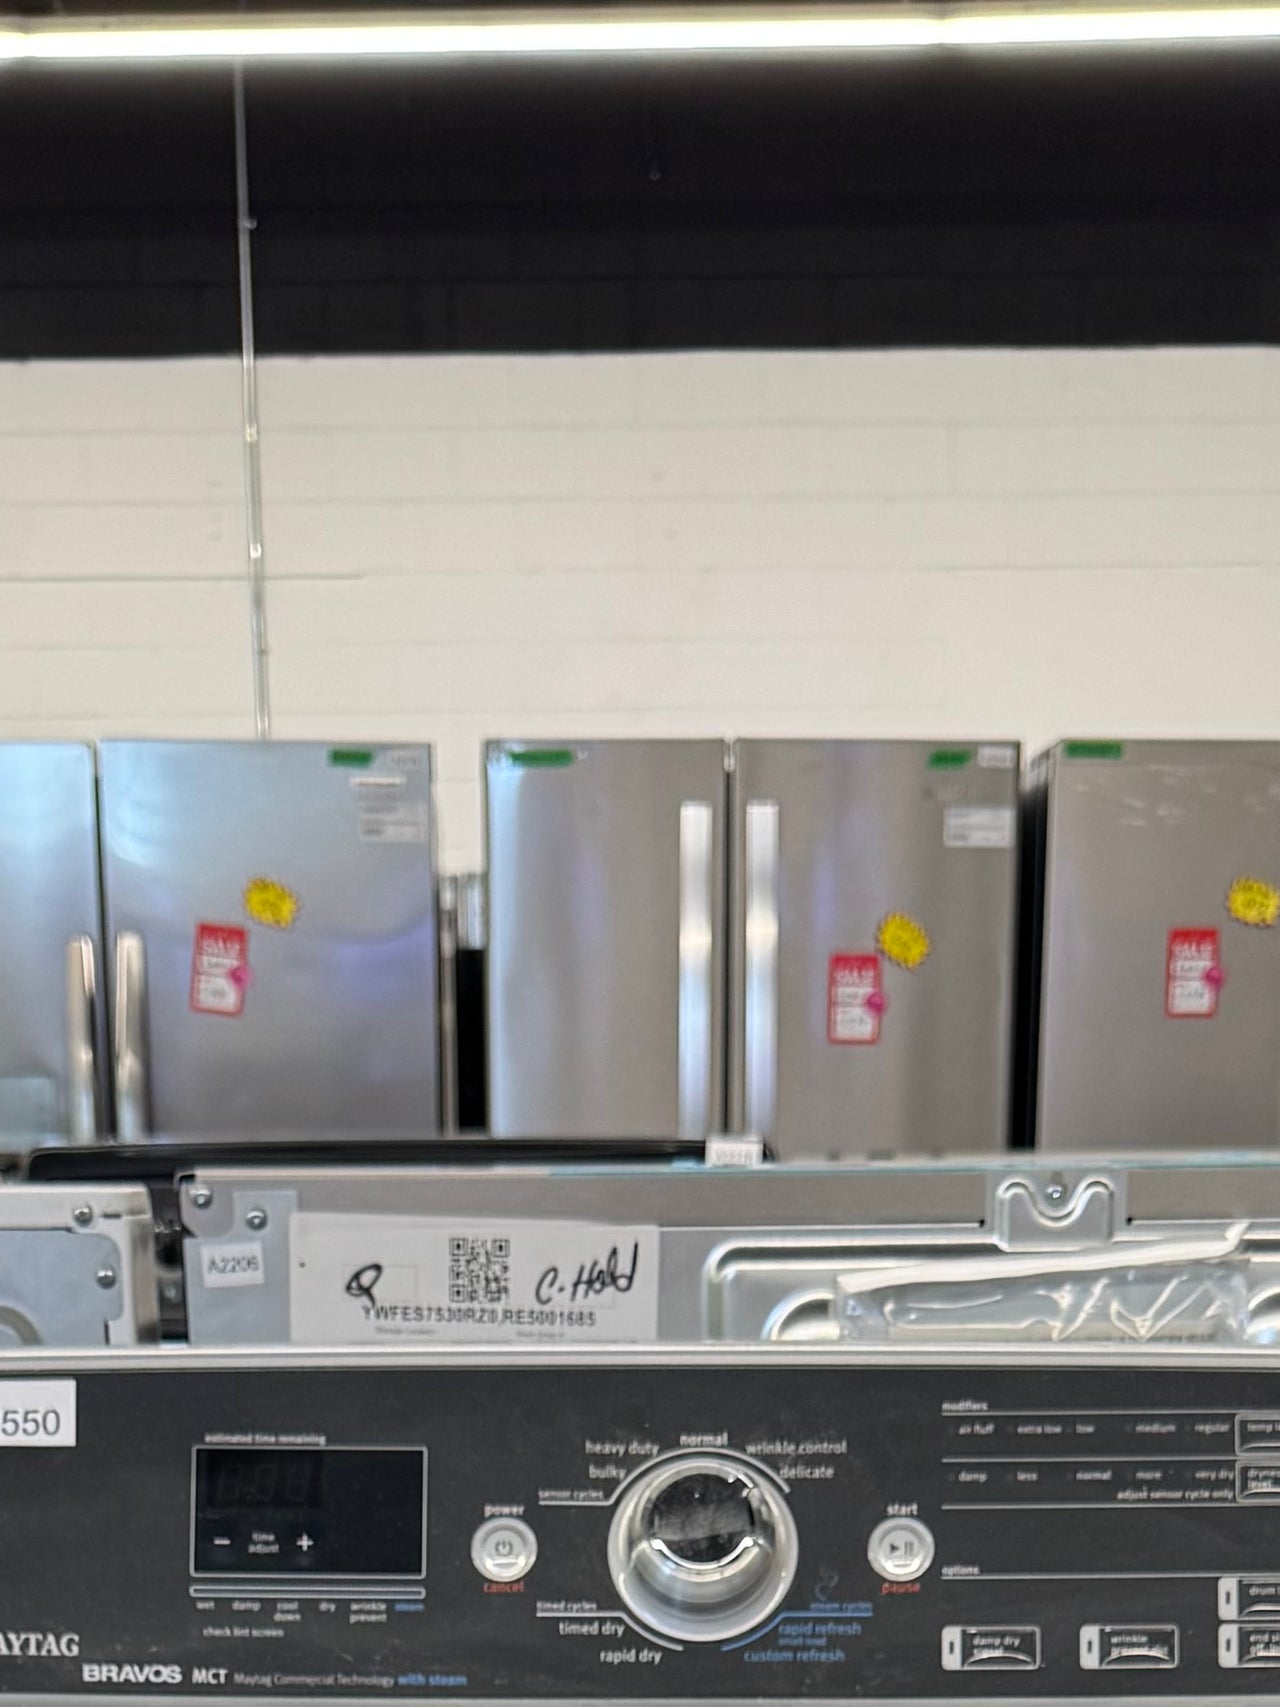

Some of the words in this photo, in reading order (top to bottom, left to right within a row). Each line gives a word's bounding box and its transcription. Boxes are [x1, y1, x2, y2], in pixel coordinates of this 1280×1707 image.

[680, 1431, 728, 1447] normal
[745, 1439, 796, 1454] wrinkle
[797, 1439, 847, 1454] control
[585, 1439, 626, 1456] heavy
[627, 1439, 659, 1456] duty
[589, 1464, 627, 1480] bulky
[780, 1464, 834, 1479] delicate
[484, 1504, 525, 1518] power
[886, 1502, 918, 1516] start
[483, 1580, 524, 1593] cancel
[881, 1582, 920, 1596] pause
[319, 1601, 336, 1613] dry
[350, 1601, 387, 1611] wrinkle
[559, 1621, 598, 1635] timed
[601, 1621, 625, 1637] dry
[778, 1621, 813, 1637] rapid
[815, 1621, 862, 1635] refresh
[972, 1634, 1001, 1648] damp
[1003, 1634, 1021, 1648] dry
[600, 1648, 636, 1664] rapid
[639, 1648, 662, 1664] dry
[744, 1649, 793, 1662] custom
[796, 1648, 846, 1662] refresh
[82, 1663, 182, 1685] BRAVOS
[191, 1667, 228, 1686] MCT
[233, 1674, 271, 1688] Maytag
[273, 1673, 335, 1687] Commercial
[336, 1674, 394, 1688] Technology
[397, 1673, 426, 1687] with
[428, 1674, 468, 1687] steam
